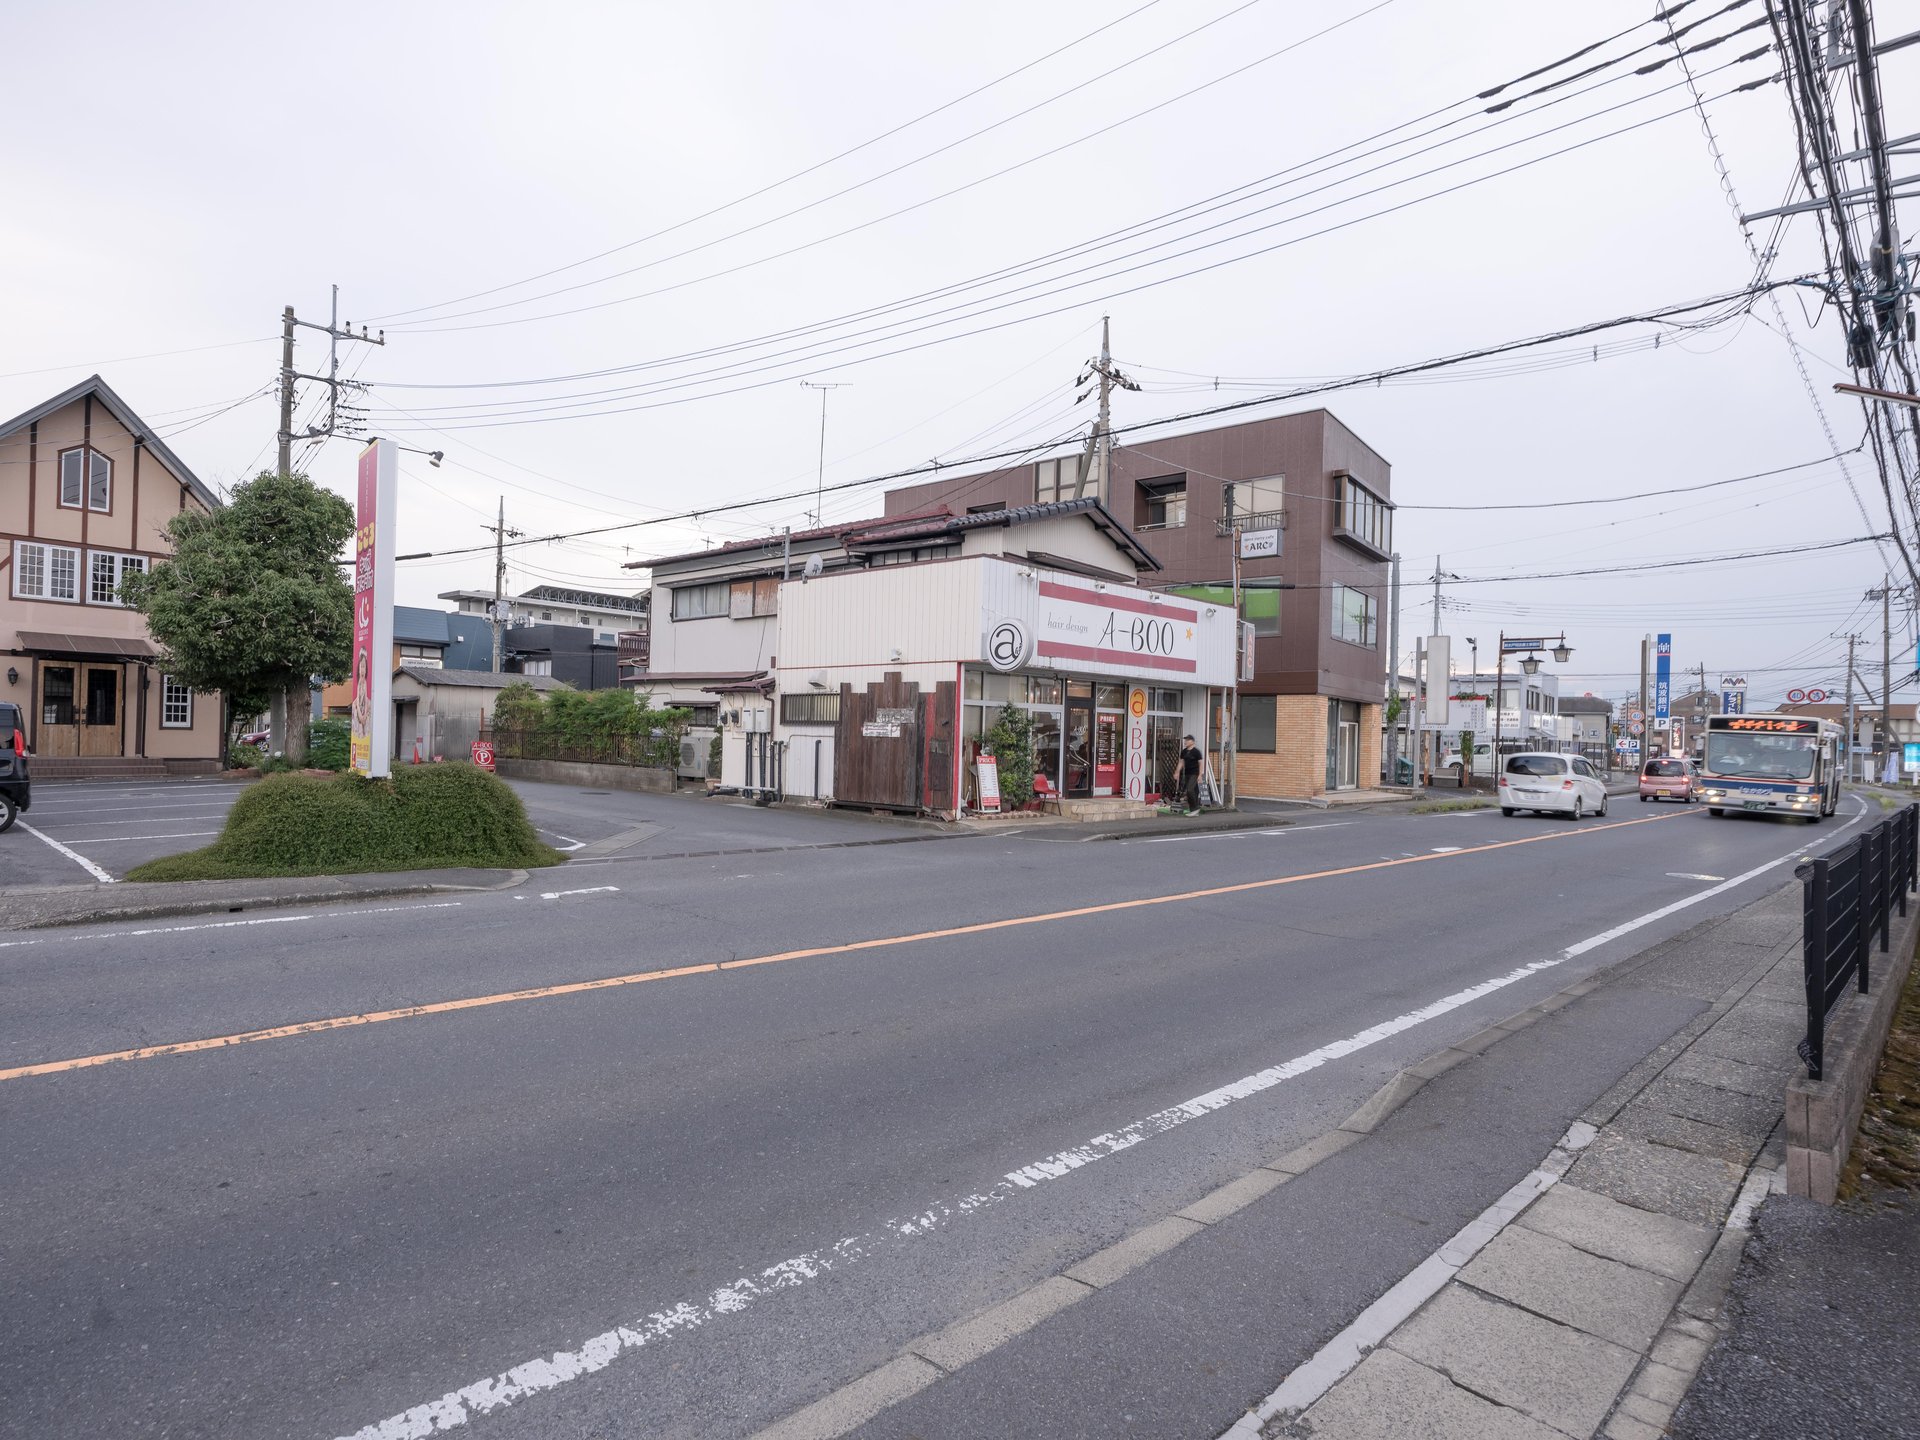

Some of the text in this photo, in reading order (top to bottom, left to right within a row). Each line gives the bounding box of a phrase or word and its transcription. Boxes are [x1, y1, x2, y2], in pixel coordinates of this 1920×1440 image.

[1249, 541, 1268, 552] ARC
[1047, 611, 1175, 656] hair design A-BOO
[1657, 681, 1668, 713] 筑波銀行
[1658, 719, 1666, 728] P
[479, 752, 489, 763] P
